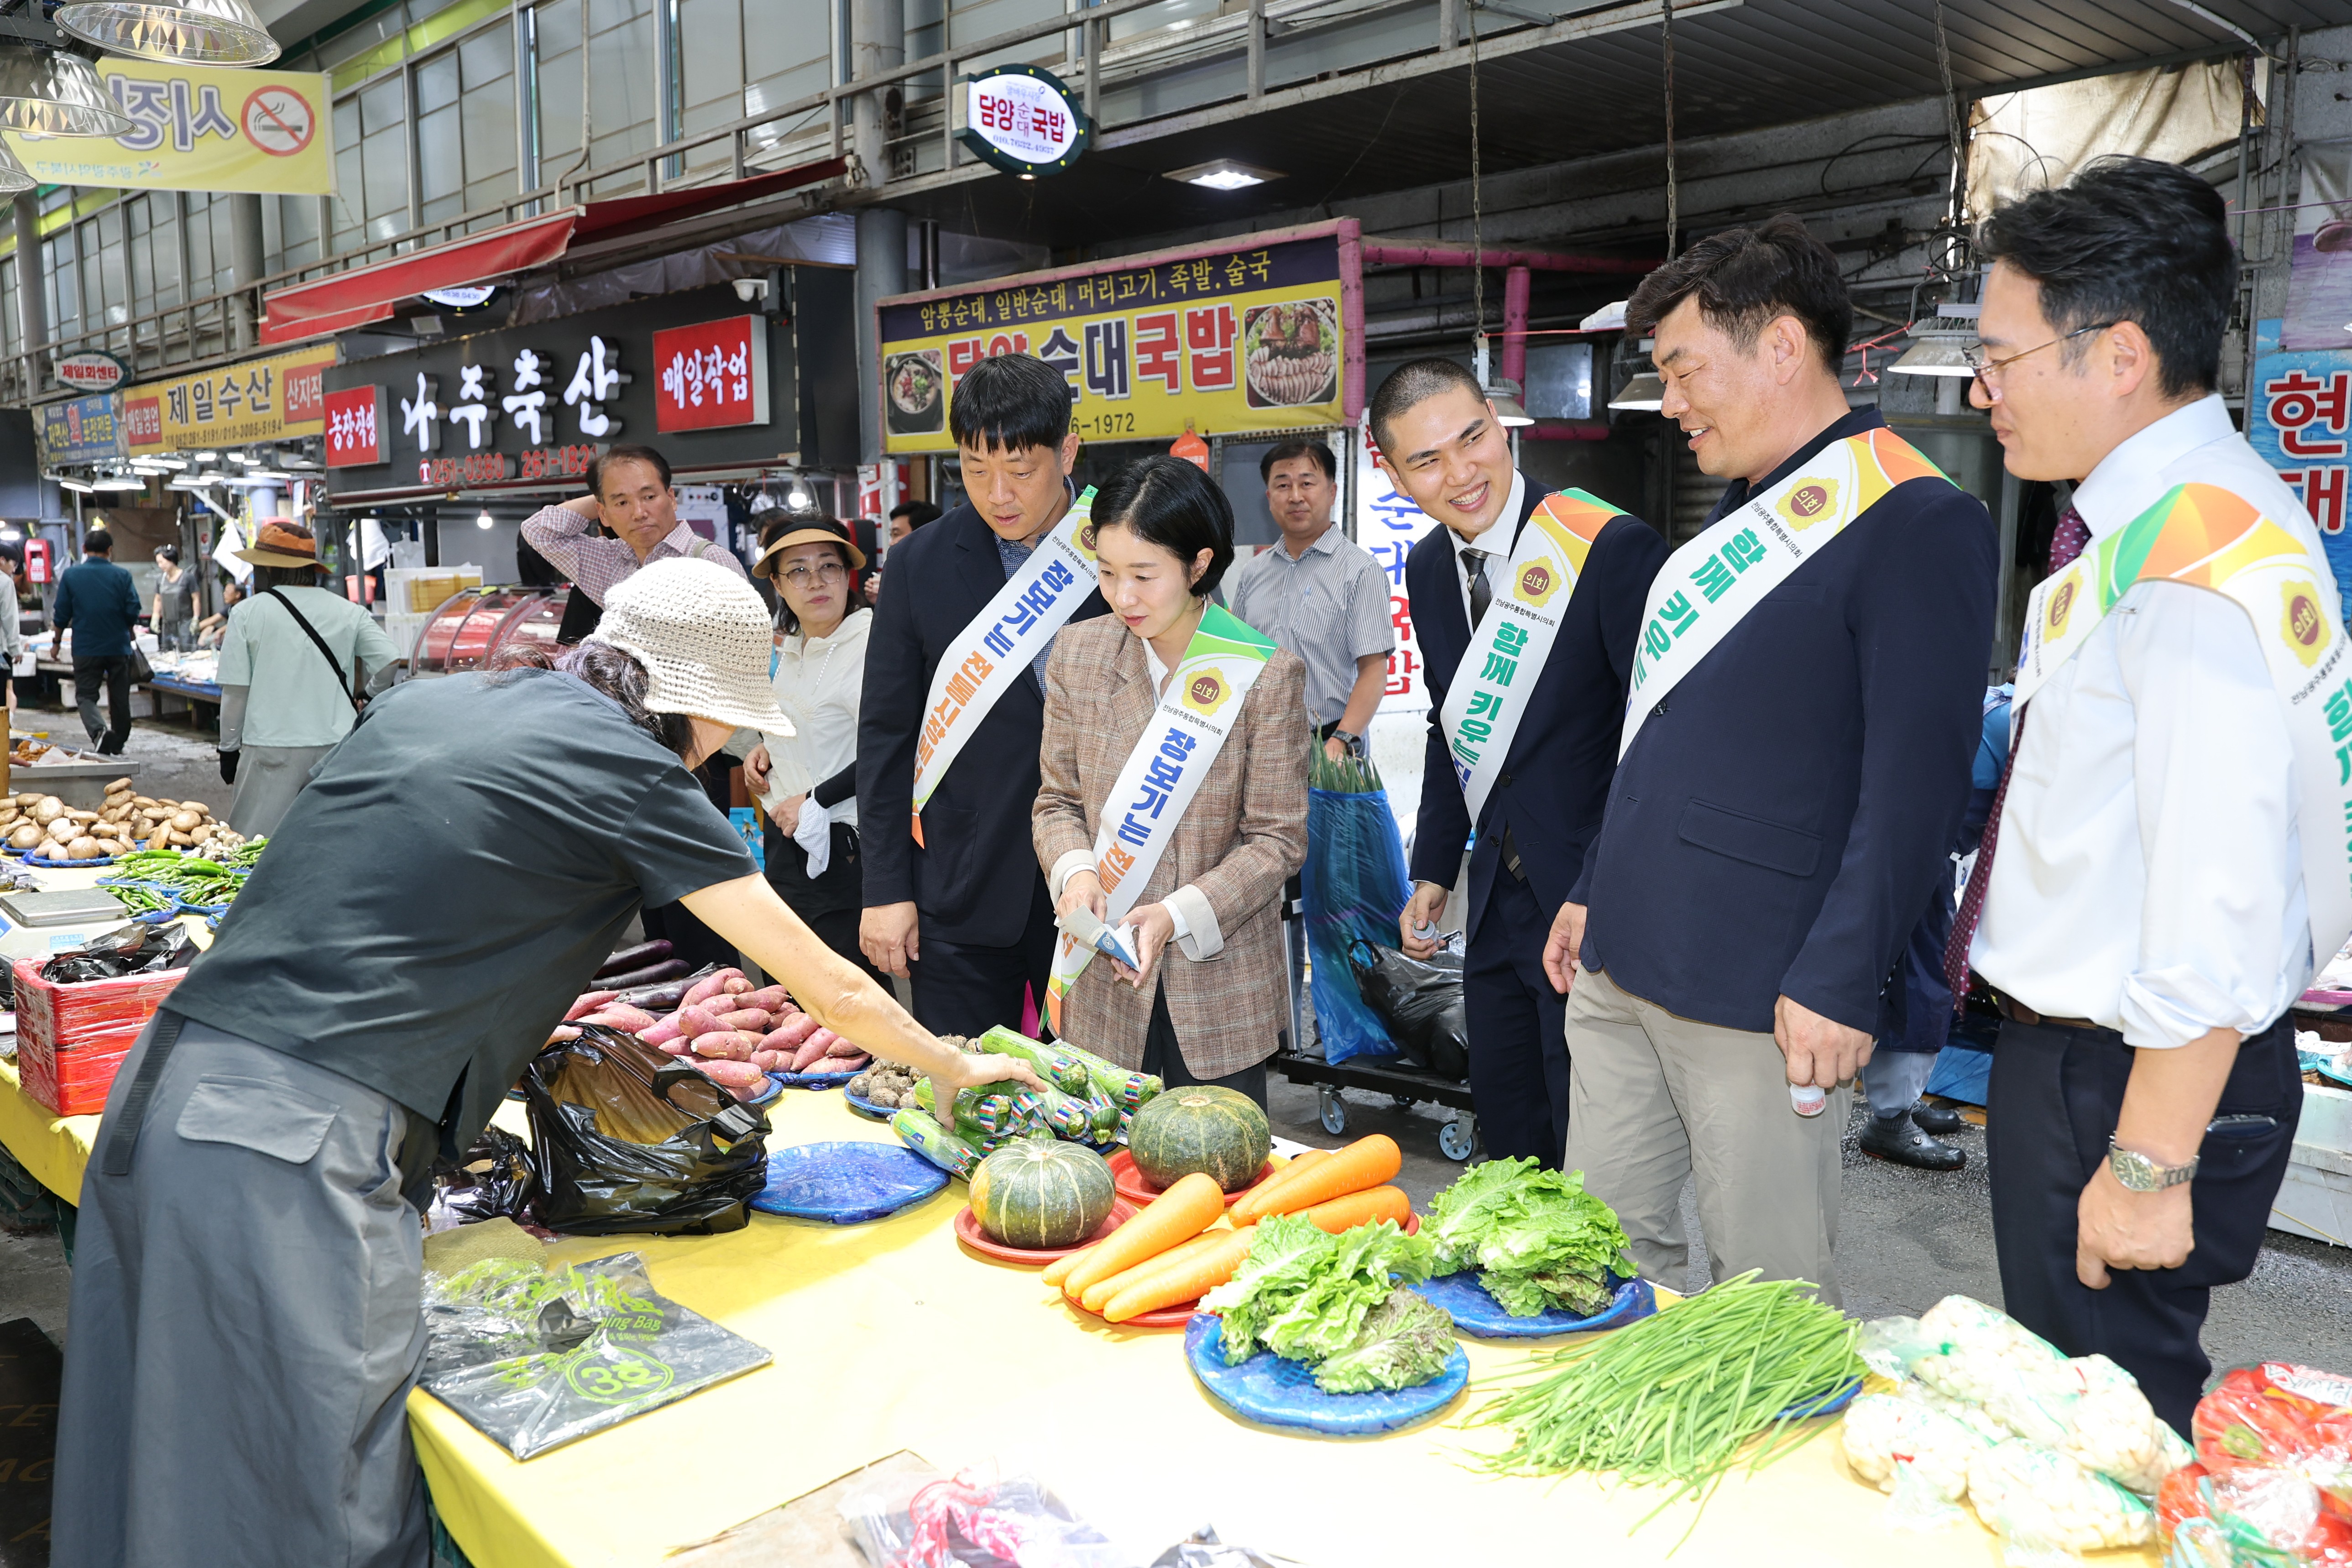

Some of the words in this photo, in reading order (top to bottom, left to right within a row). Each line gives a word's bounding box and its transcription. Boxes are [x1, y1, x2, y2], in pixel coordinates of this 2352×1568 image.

[1224, 251, 1271, 287] 술국
[62, 364, 118, 380] 제일회센터
[662, 341, 748, 410] 매일작업
[167, 365, 273, 427] 제일수산
[400, 334, 620, 452] 나주축산
[127, 403, 159, 436] 매일영업
[328, 402, 376, 451] 농장직영
[1068, 413, 1135, 434] 6-1972
[432, 452, 506, 484] 251-0380
[1794, 490, 1824, 515] 의회
[1751, 501, 1803, 559] 전남광주통합특별시의회
[1052, 535, 1098, 582] 전남광주통합특별시의회
[1689, 527, 1768, 605] 함께
[1523, 573, 1548, 592] 의회
[983, 559, 1075, 659] 장보기는
[1495, 597, 1556, 627] 전남광주통합특별시의회
[2294, 600, 2317, 641] 의회
[1479, 621, 1529, 687] 함께
[1634, 589, 1700, 692] 키우는
[1192, 683, 1218, 700] 의회
[1163, 704, 1223, 736] 전남광주통합특별시의회
[1451, 690, 1504, 766] 키우는
[1117, 727, 1197, 847] 장보기는
[632, 1315, 662, 1332] Bag
[580, 1359, 663, 1396] 3호
